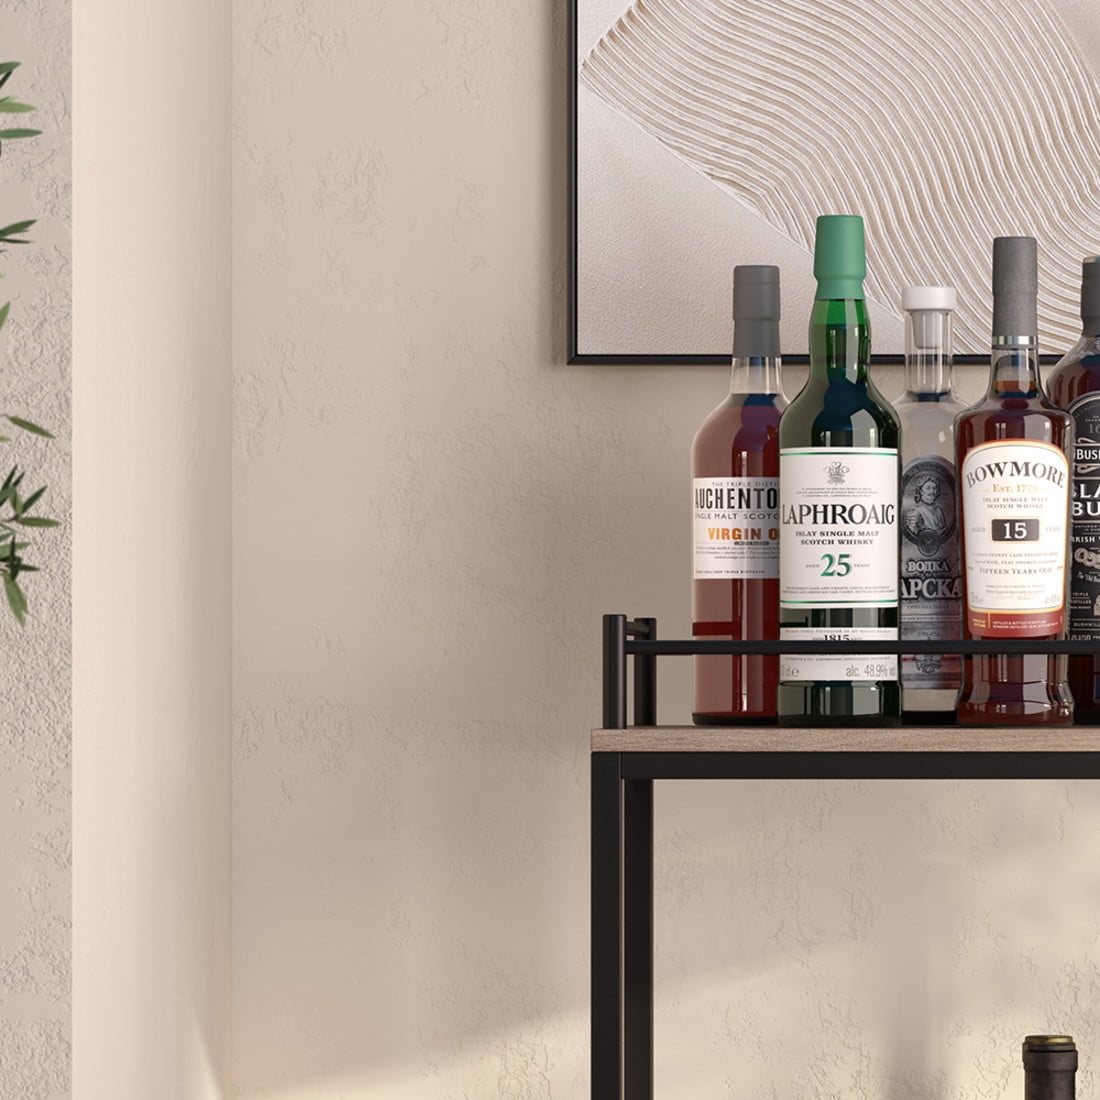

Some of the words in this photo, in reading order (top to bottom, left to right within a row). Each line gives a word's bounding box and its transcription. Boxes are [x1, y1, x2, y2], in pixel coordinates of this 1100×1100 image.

[966, 460, 1065, 488] BOWMORE
[782, 503, 895, 525] LAPHROAIG
[707, 527, 762, 541] VIRGIN
[1003, 522, 1027, 539] 15
[820, 553, 851, 577] 25
[1011, 567, 1038, 575] YEARS
